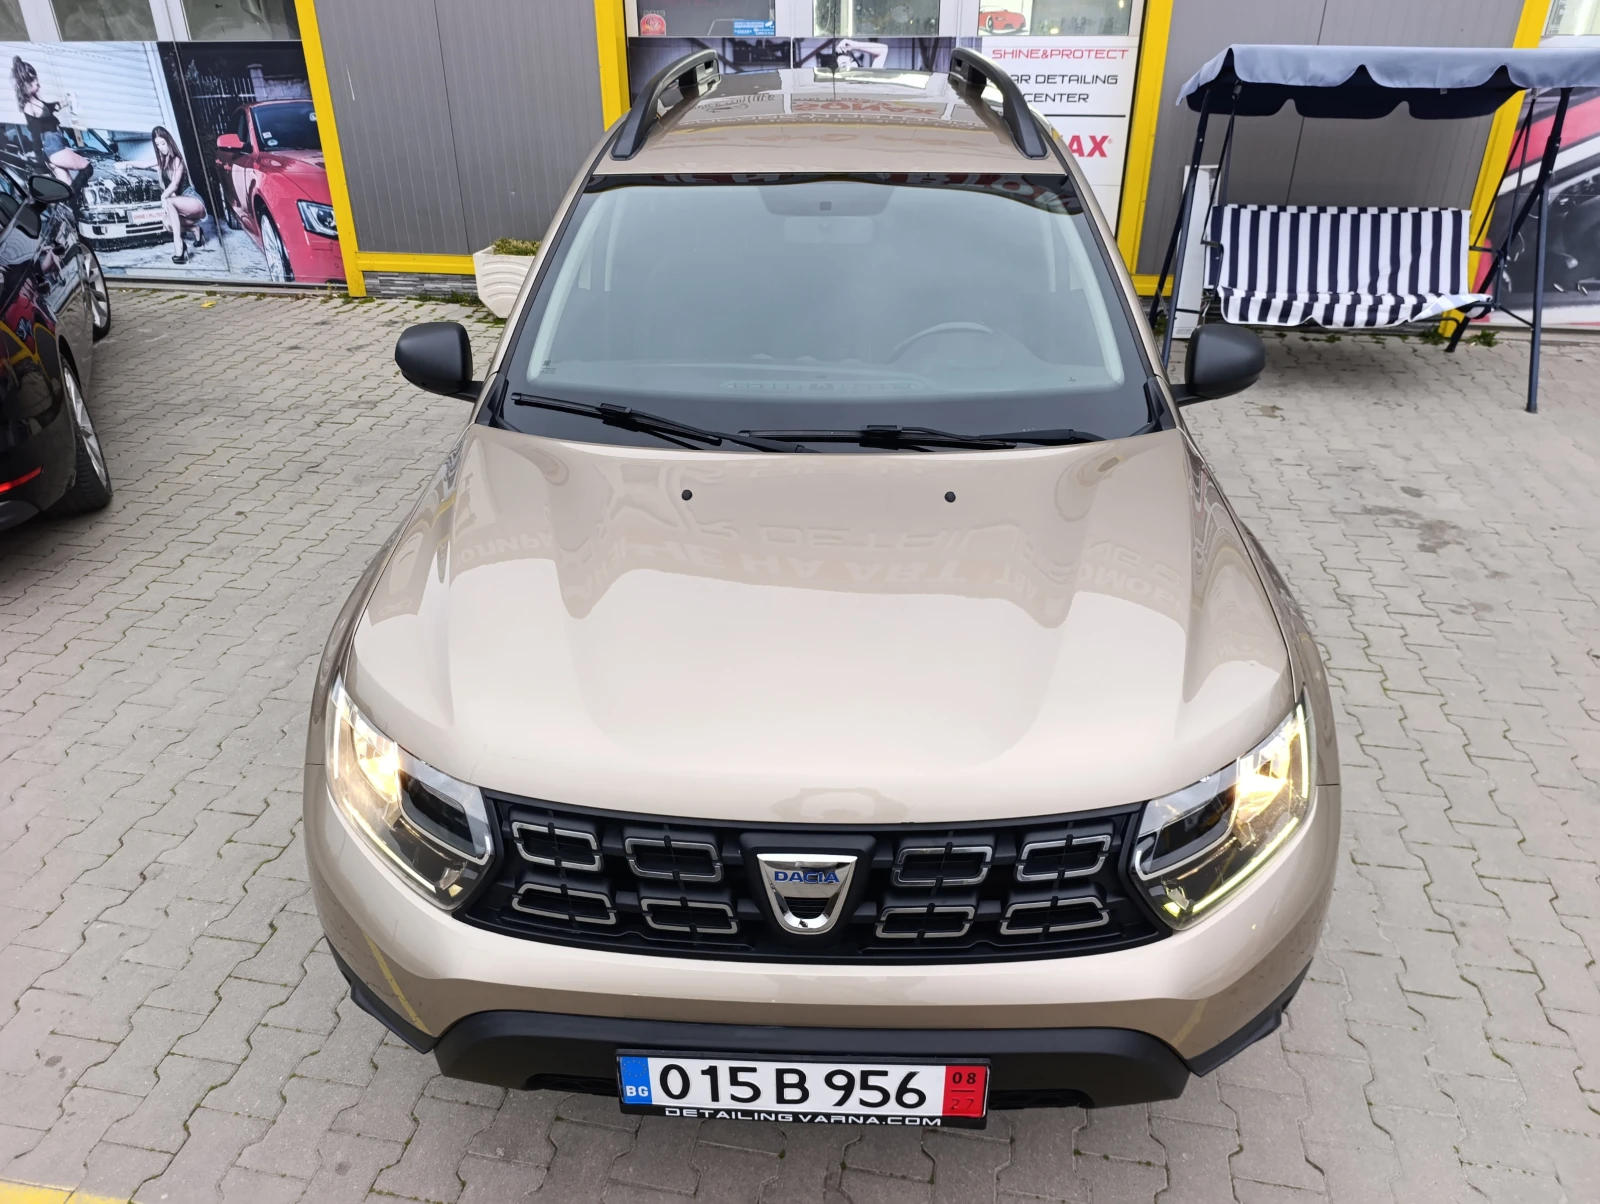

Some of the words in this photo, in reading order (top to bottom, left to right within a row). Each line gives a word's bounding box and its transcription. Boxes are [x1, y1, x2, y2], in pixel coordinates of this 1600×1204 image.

[992, 48, 1130, 60] SHINE&PROTECT
[1010, 74, 1031, 84] AR
[1035, 74, 1118, 85] DETAILING
[1022, 93, 1090, 103] CENTER
[774, 870, 840, 884] DACIA
[952, 1071, 977, 1085] 08
[626, 1085, 649, 1097] BG
[659, 1063, 762, 1104] 015
[824, 1068, 927, 1109] 956
[951, 1098, 975, 1111] 27
